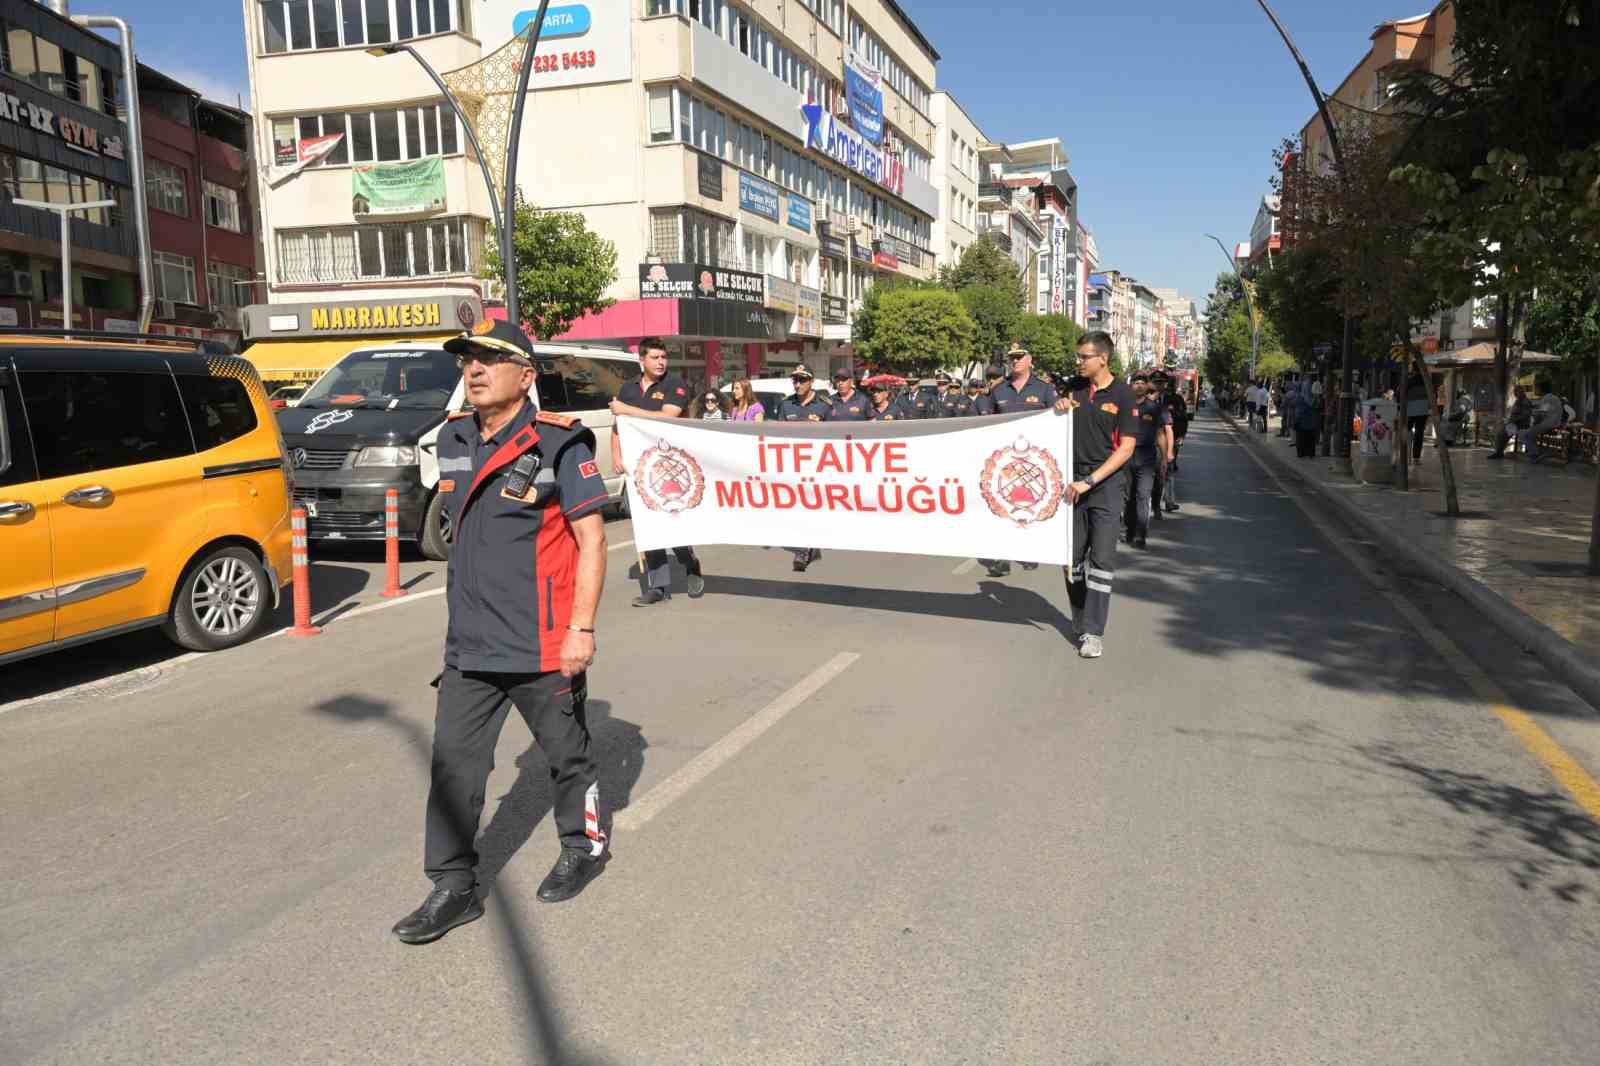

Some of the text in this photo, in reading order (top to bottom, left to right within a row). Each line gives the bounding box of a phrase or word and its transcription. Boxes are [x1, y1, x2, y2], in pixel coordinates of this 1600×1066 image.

[534, 54, 559, 73] 232
[562, 50, 596, 71] 5433
[59, 115, 98, 151] GYM
[658, 281, 694, 293] SELÇUK
[732, 273, 762, 292] SELÇUK
[311, 303, 441, 330] MARRAKESH
[758, 434, 909, 473] İTFAİYE
[714, 477, 966, 515] MÜDÜRLÜĞÜ
